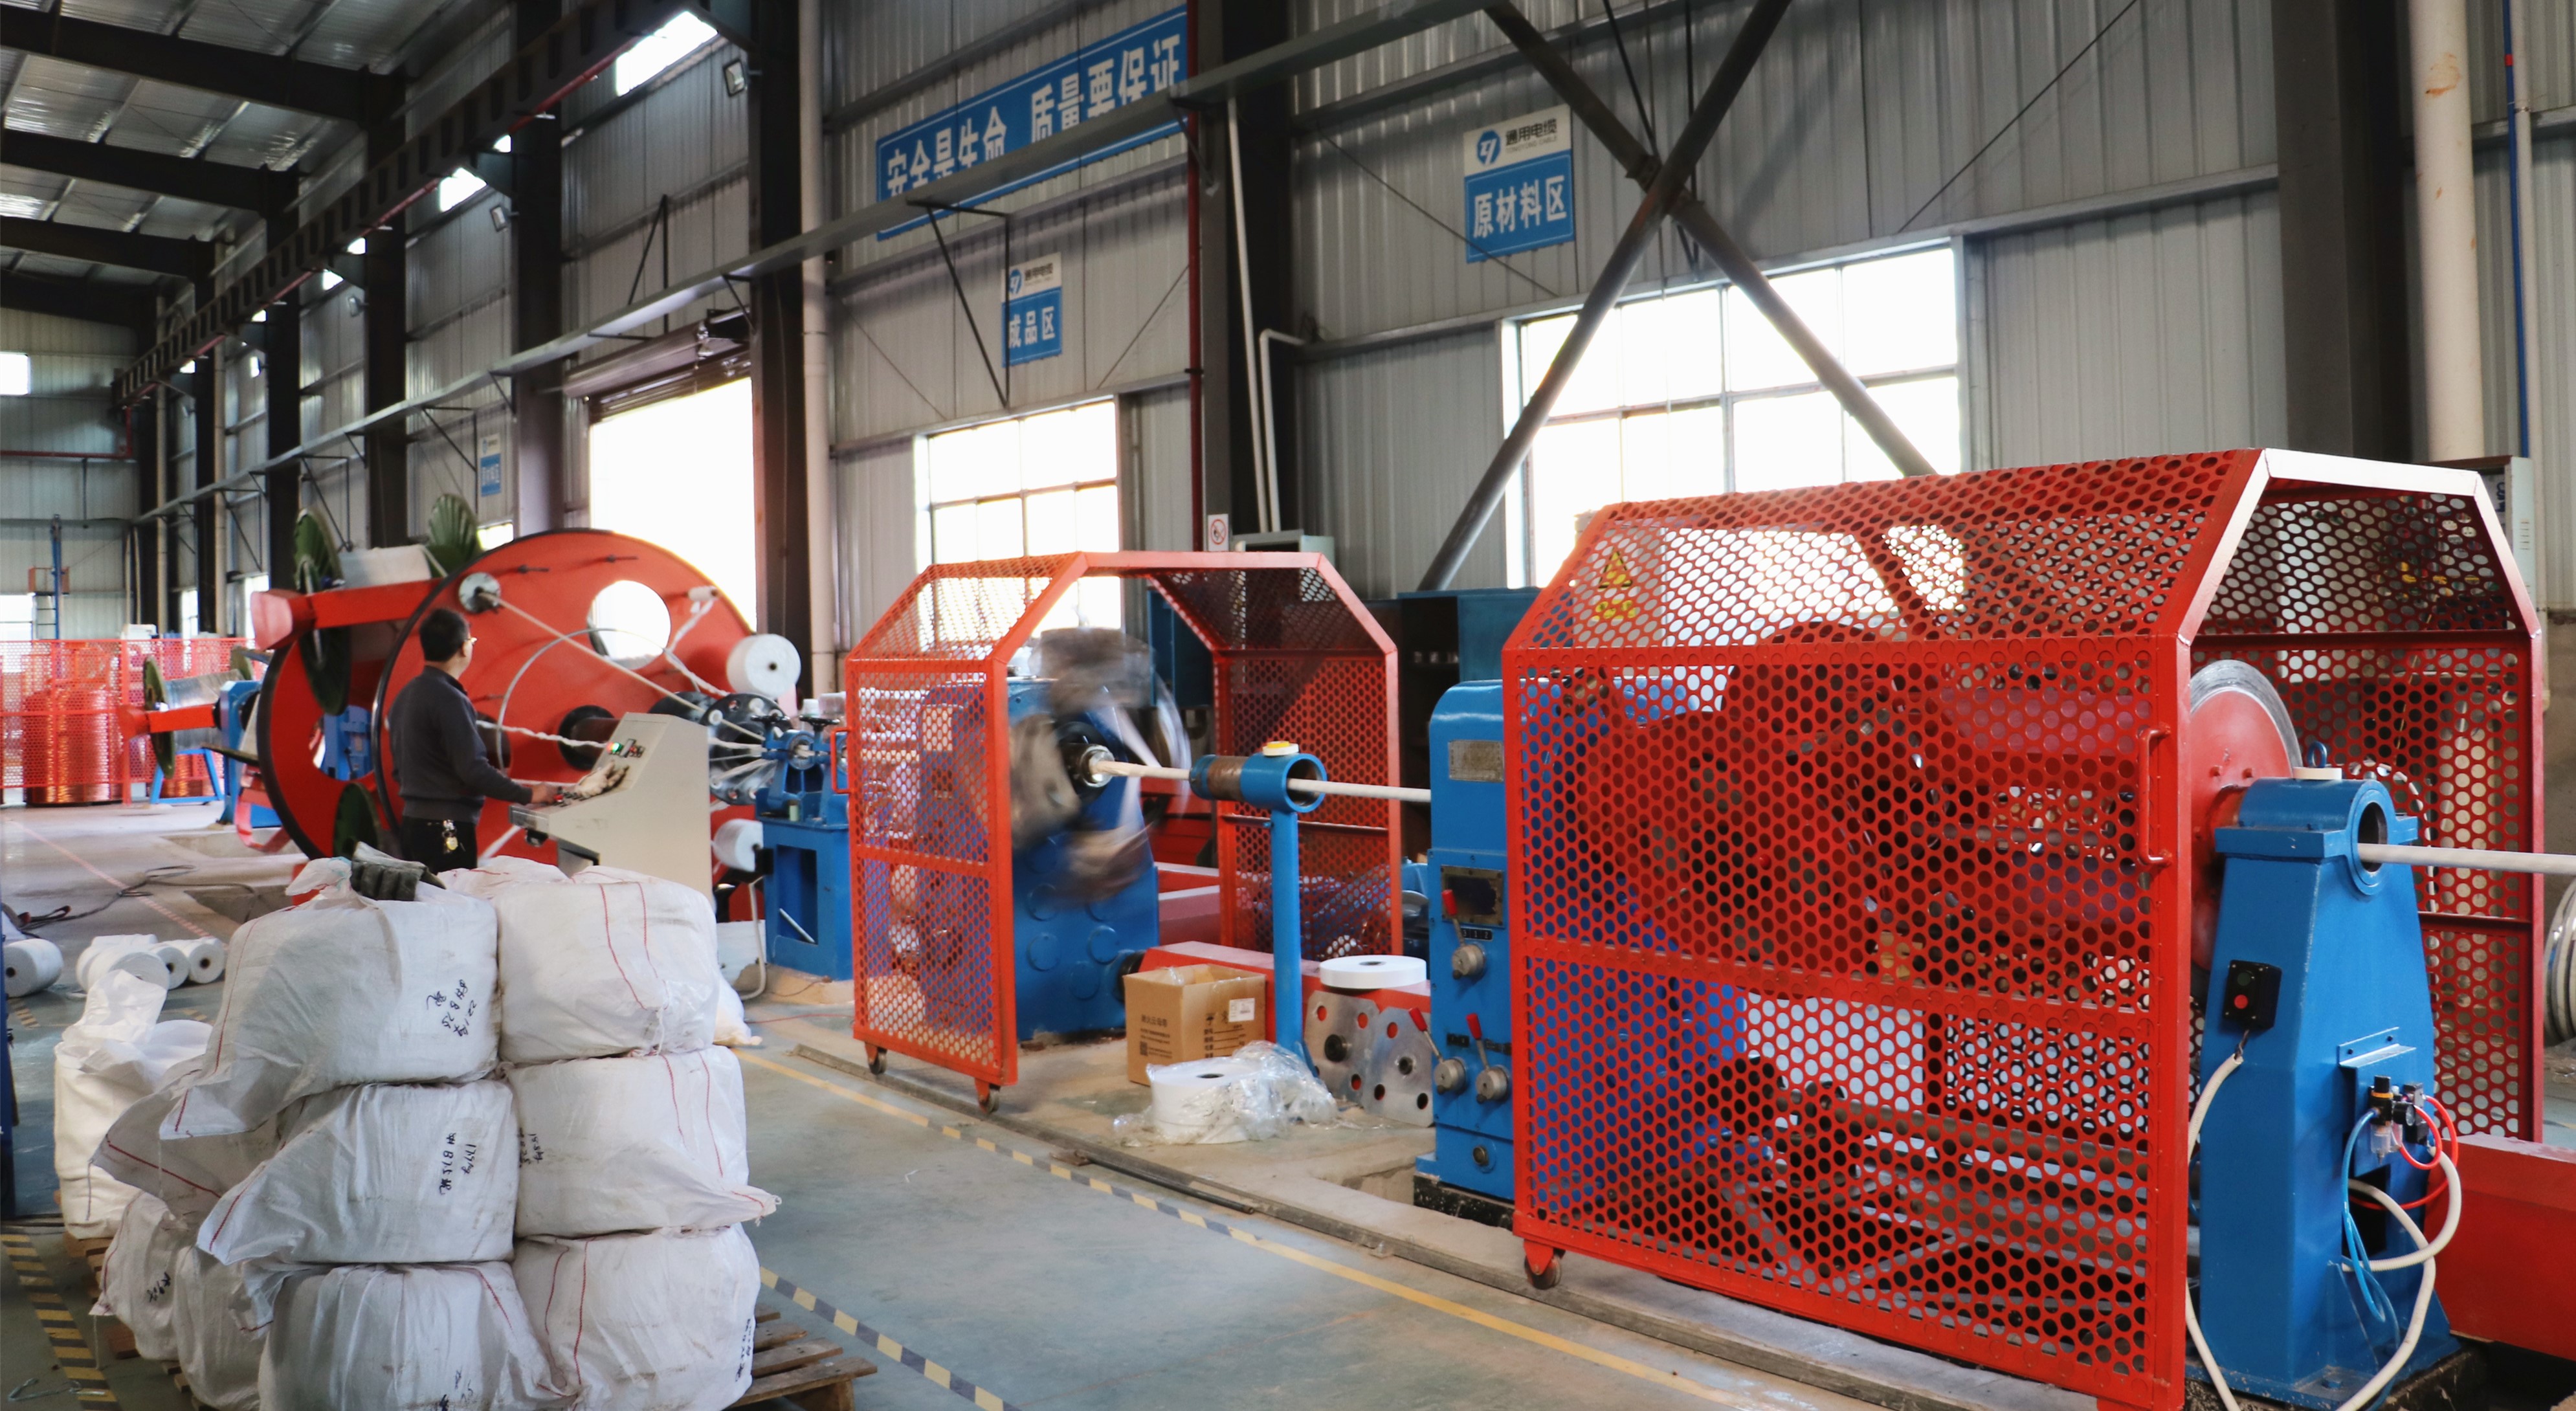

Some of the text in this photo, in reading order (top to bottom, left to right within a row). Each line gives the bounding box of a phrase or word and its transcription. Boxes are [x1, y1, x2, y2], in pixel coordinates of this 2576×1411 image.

[887, 34, 1180, 197] 安全是生命 质量要保证
[1505, 118, 1557, 146] 通用电缆
[1473, 175, 1567, 238] 原材料区
[1009, 306, 1056, 348] 成品区
